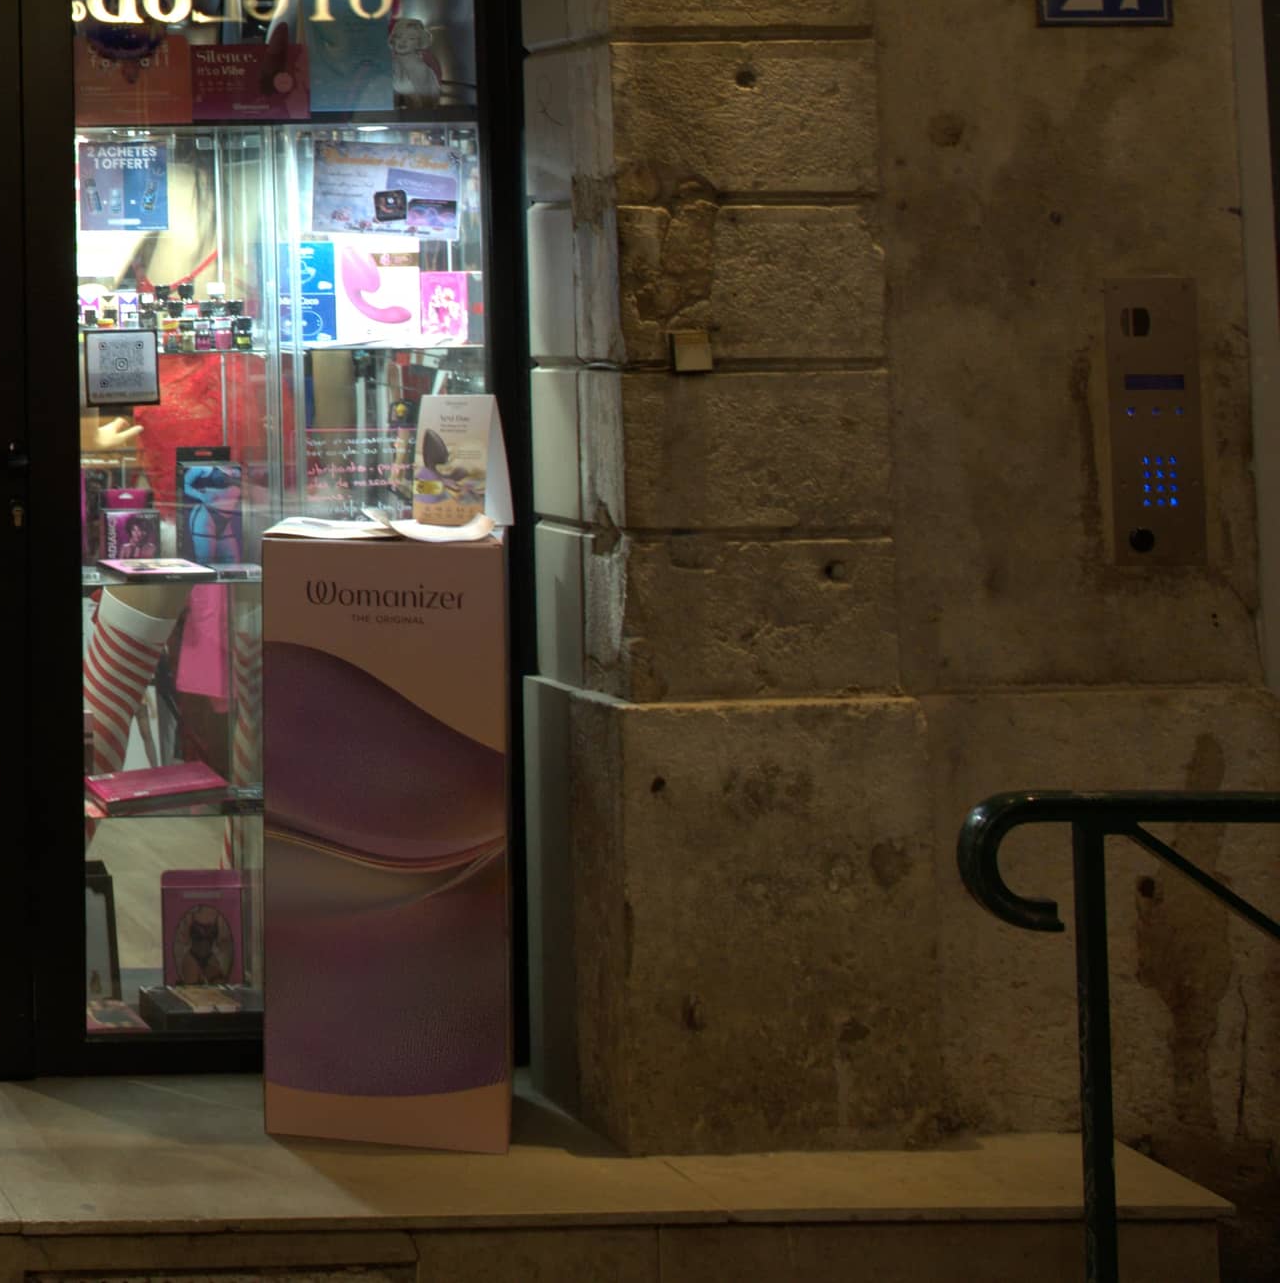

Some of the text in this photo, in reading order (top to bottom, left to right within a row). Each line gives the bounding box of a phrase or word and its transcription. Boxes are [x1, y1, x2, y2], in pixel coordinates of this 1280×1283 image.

[87, 146, 98, 157] 2
[305, 579, 465, 610] Womanizer
[351, 613, 425, 625] THE ORIGINAL
